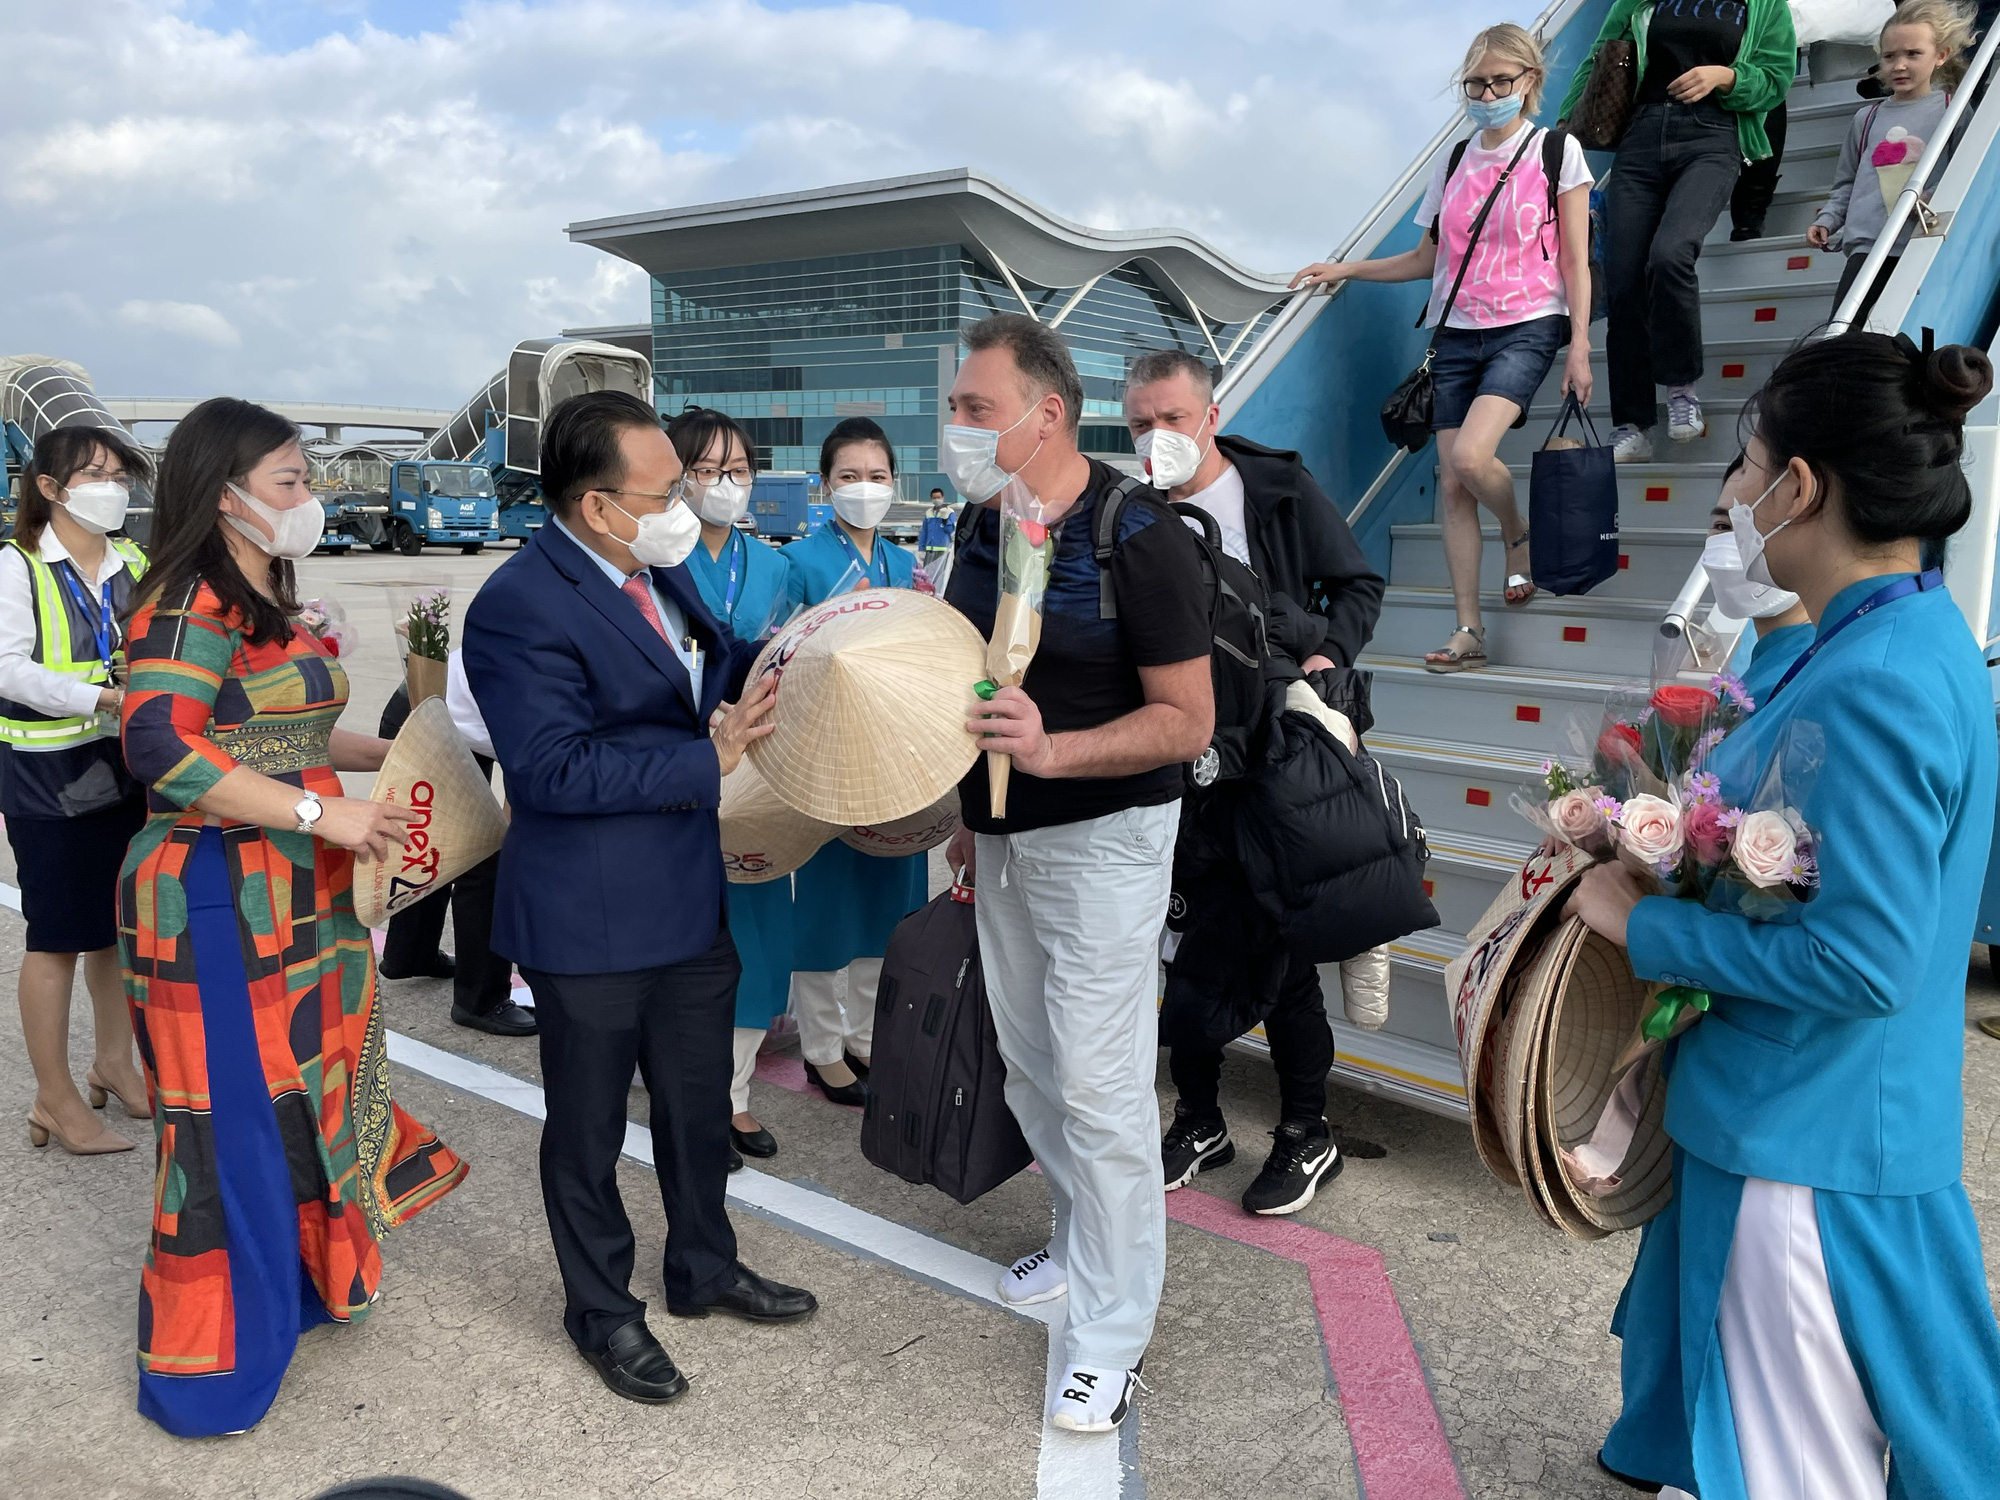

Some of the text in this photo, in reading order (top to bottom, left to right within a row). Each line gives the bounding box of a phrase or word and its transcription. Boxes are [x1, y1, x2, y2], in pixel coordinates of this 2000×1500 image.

[460, 503, 474, 511] AGS
[798, 600, 890, 636] anex
[400, 780, 435, 873] anex
